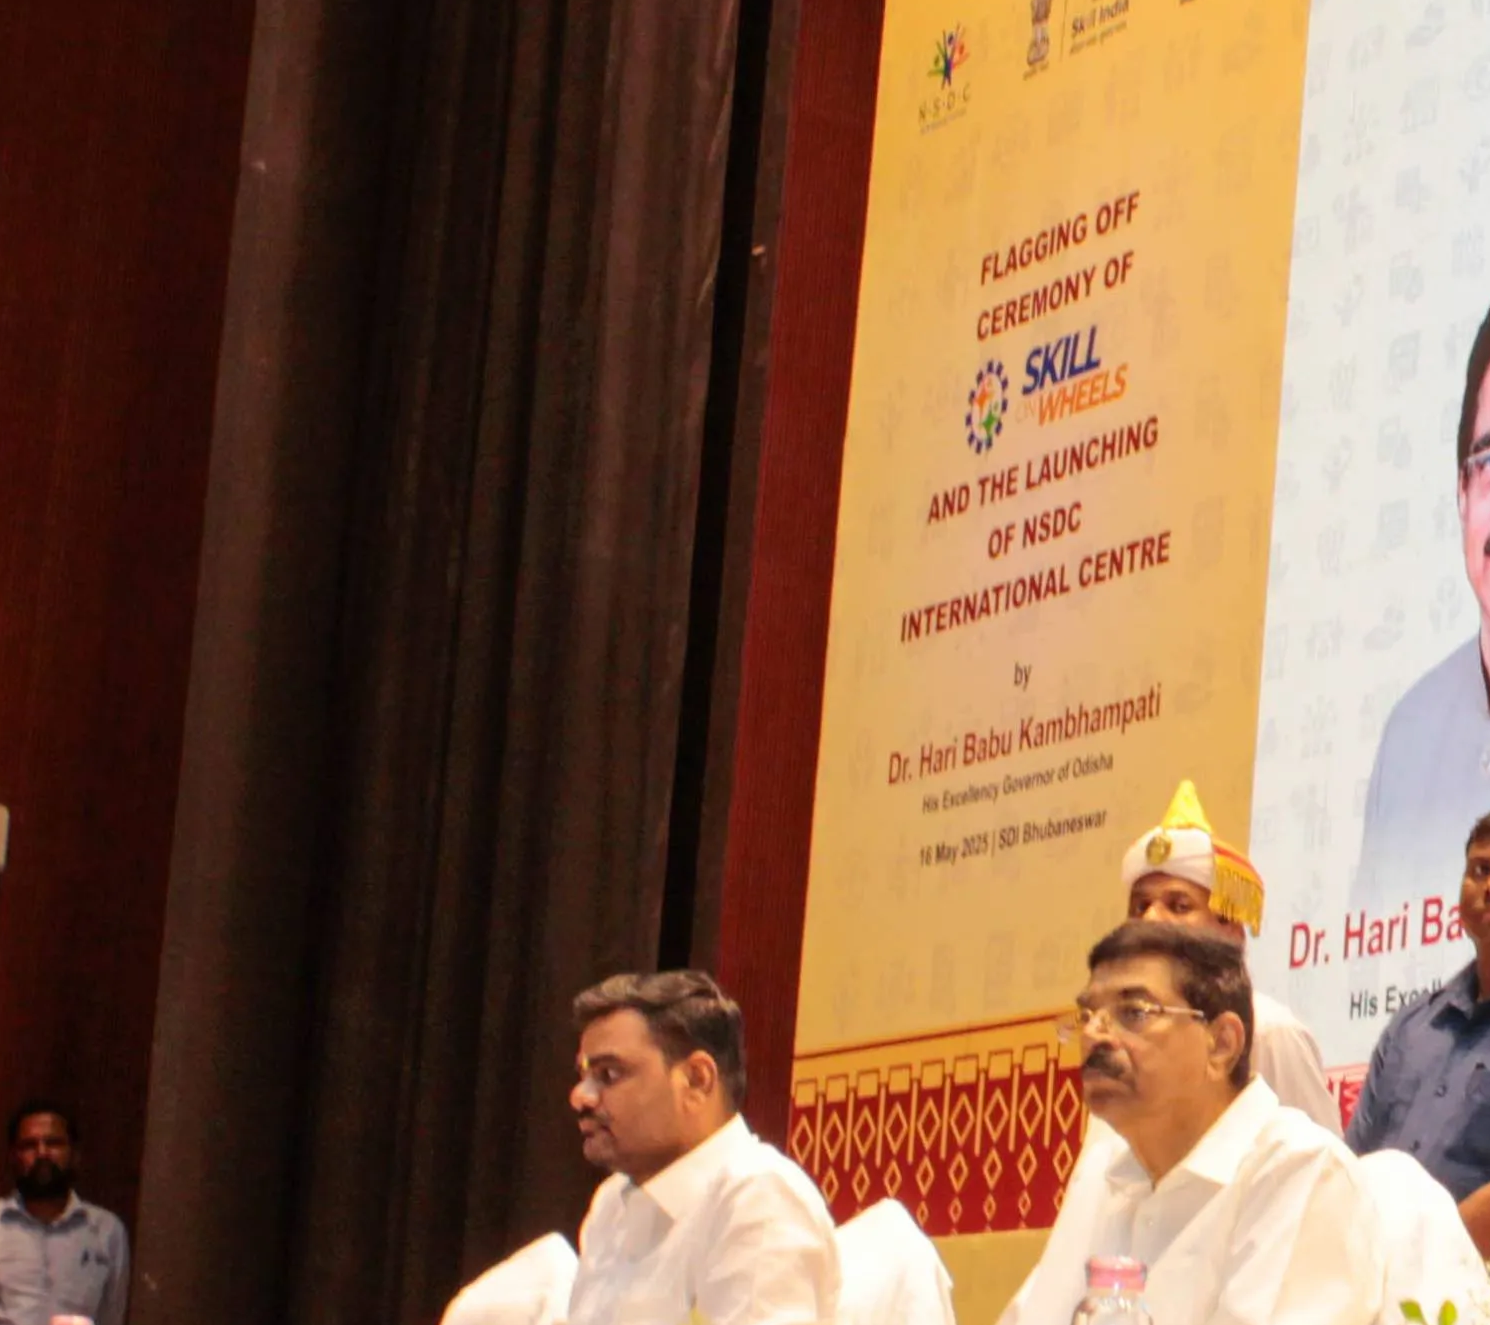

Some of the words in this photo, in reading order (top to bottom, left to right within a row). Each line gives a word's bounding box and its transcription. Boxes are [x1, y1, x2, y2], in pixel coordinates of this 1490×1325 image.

[980, 213, 1087, 285] FLAGGING
[1095, 191, 1140, 235] OFF
[976, 265, 1096, 341] CEREMONY
[1103, 251, 1134, 289] OF
[1022, 324, 1102, 396] SKILL
[928, 484, 970, 524] AND
[978, 465, 1019, 507] THE
[1025, 416, 1158, 491] LAUNCHING
[987, 524, 1015, 559] OF
[1022, 502, 1082, 548] NSDC
[900, 565, 1070, 643] INTERNATIONAL
[1078, 531, 1171, 588] CENTRE
[1014, 661, 1032, 690] by
[888, 751, 913, 785] Dr.
[920, 738, 957, 778] Hari
[963, 730, 1011, 767] Babu
[1018, 683, 1162, 752] Kambhampati
[935, 839, 958, 865] May
[961, 831, 989, 859] 2025
[999, 823, 1019, 850] SDI
[1288, 921, 1330, 969] Dr.
[1343, 901, 1409, 960] Hari
[1421, 895, 1465, 946] Ba
[1350, 990, 1378, 1019] His
